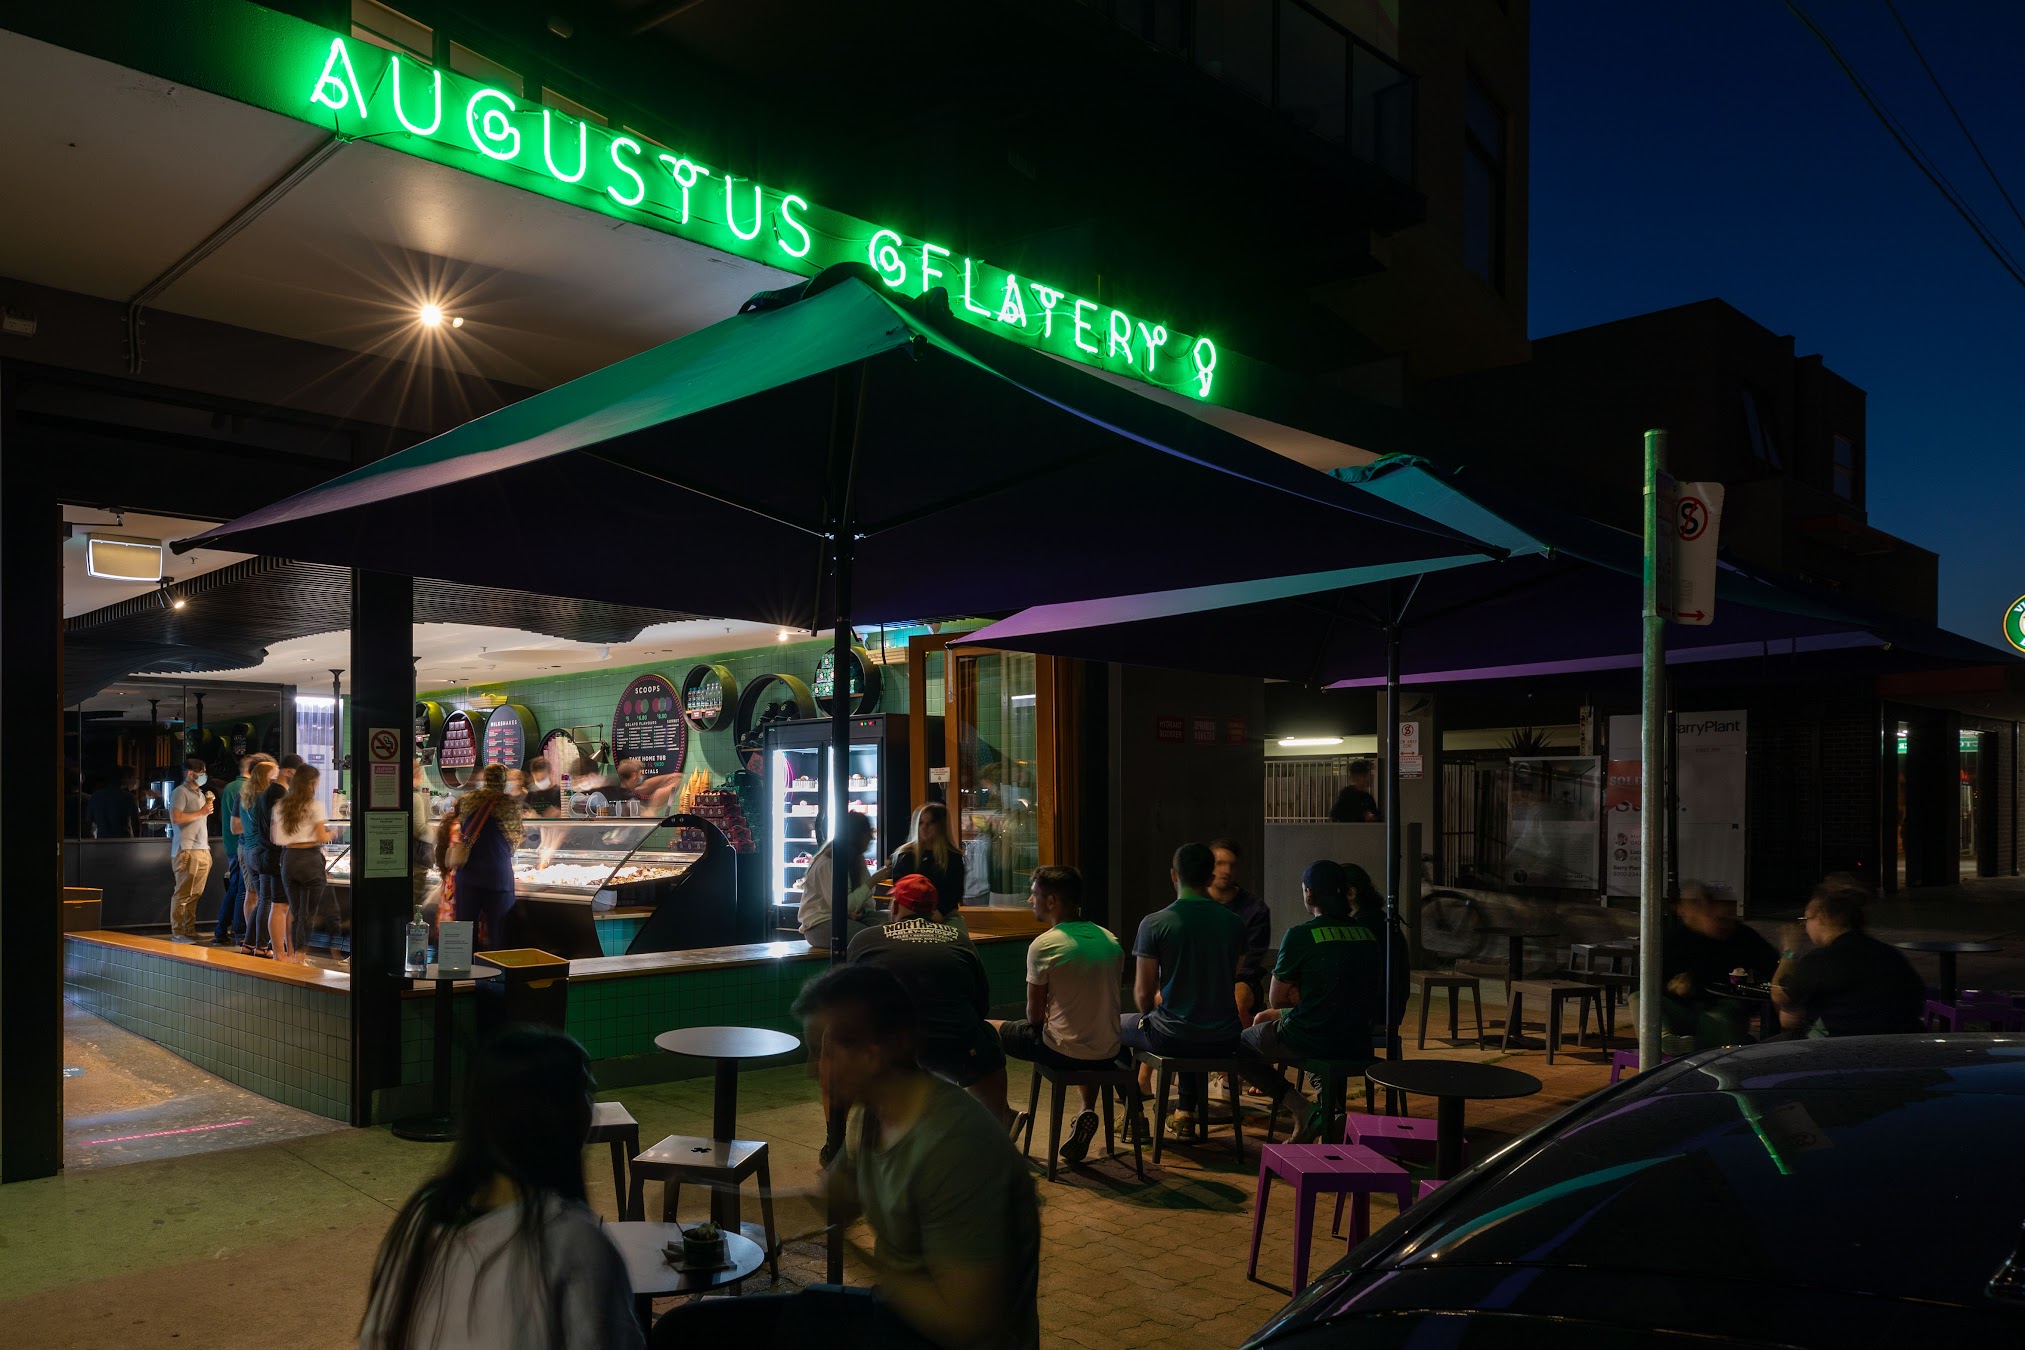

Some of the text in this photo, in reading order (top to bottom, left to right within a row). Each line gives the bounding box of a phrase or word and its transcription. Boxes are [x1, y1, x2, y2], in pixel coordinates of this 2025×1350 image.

[310, 37, 811, 259] AUGUSTUS
[635, 685, 660, 694] SCOOPS
[490, 719, 518, 728] MILKSHAKES
[1159, 720, 1182, 728] HYDRANT
[1677, 720, 1741, 736] arryPlant
[883, 918, 957, 934] NORTHSIDE
[92, 1135, 141, 1144] PLEASE
[190, 1122, 244, 1131] OUTSIDE
